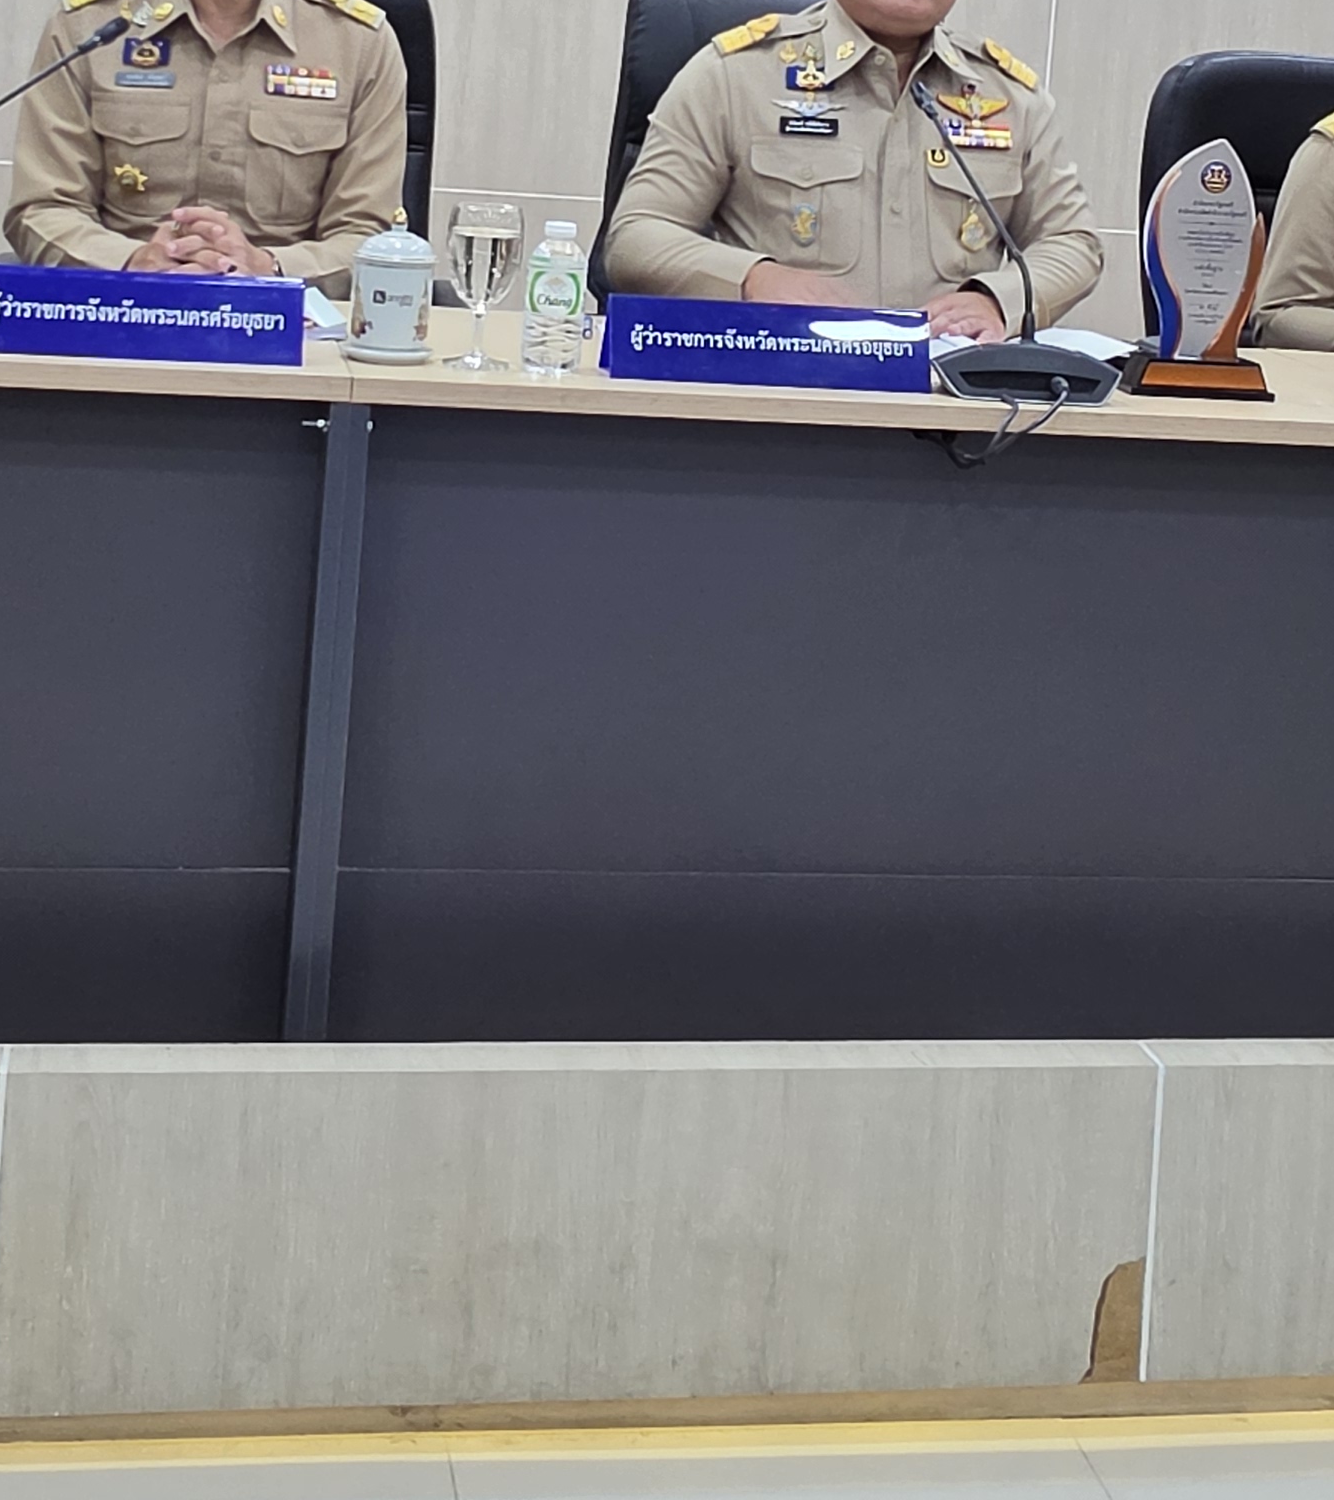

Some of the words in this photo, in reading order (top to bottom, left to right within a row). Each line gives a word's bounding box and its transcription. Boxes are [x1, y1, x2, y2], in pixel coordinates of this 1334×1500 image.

[630, 323, 914, 361] ผู้ว่าราชการจังหวัดพระนครศรอยุธยา
